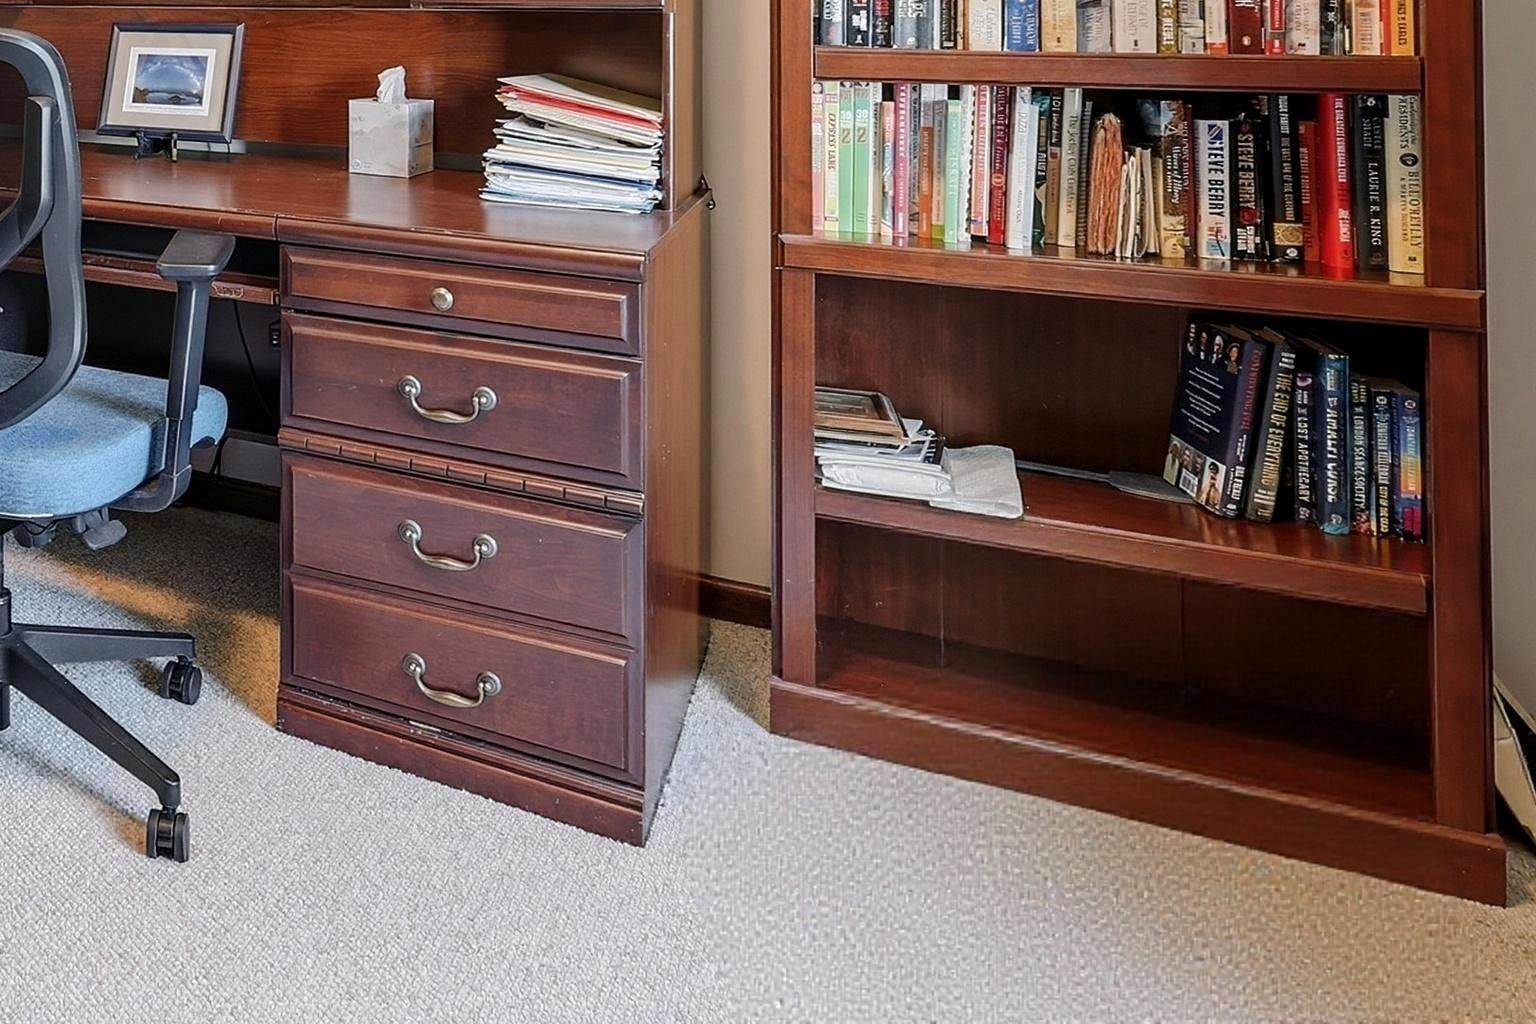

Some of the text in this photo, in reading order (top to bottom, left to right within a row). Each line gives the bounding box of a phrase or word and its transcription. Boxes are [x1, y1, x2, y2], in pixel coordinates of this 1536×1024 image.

[1208, 139, 1225, 175] STEVE
[1237, 133, 1256, 209] STEVE BERRY
[1407, 170, 1421, 195] BILL
[1208, 179, 1225, 217] BERRY
[1367, 162, 1382, 246] LAURIE R. KING
[1261, 372, 1293, 486] THE END OF EVERYTHING
[1326, 408, 1339, 459] AMALFI
[1352, 415, 1365, 445] LONDON
[1297, 416, 1310, 503] LOST APOTHECARY
